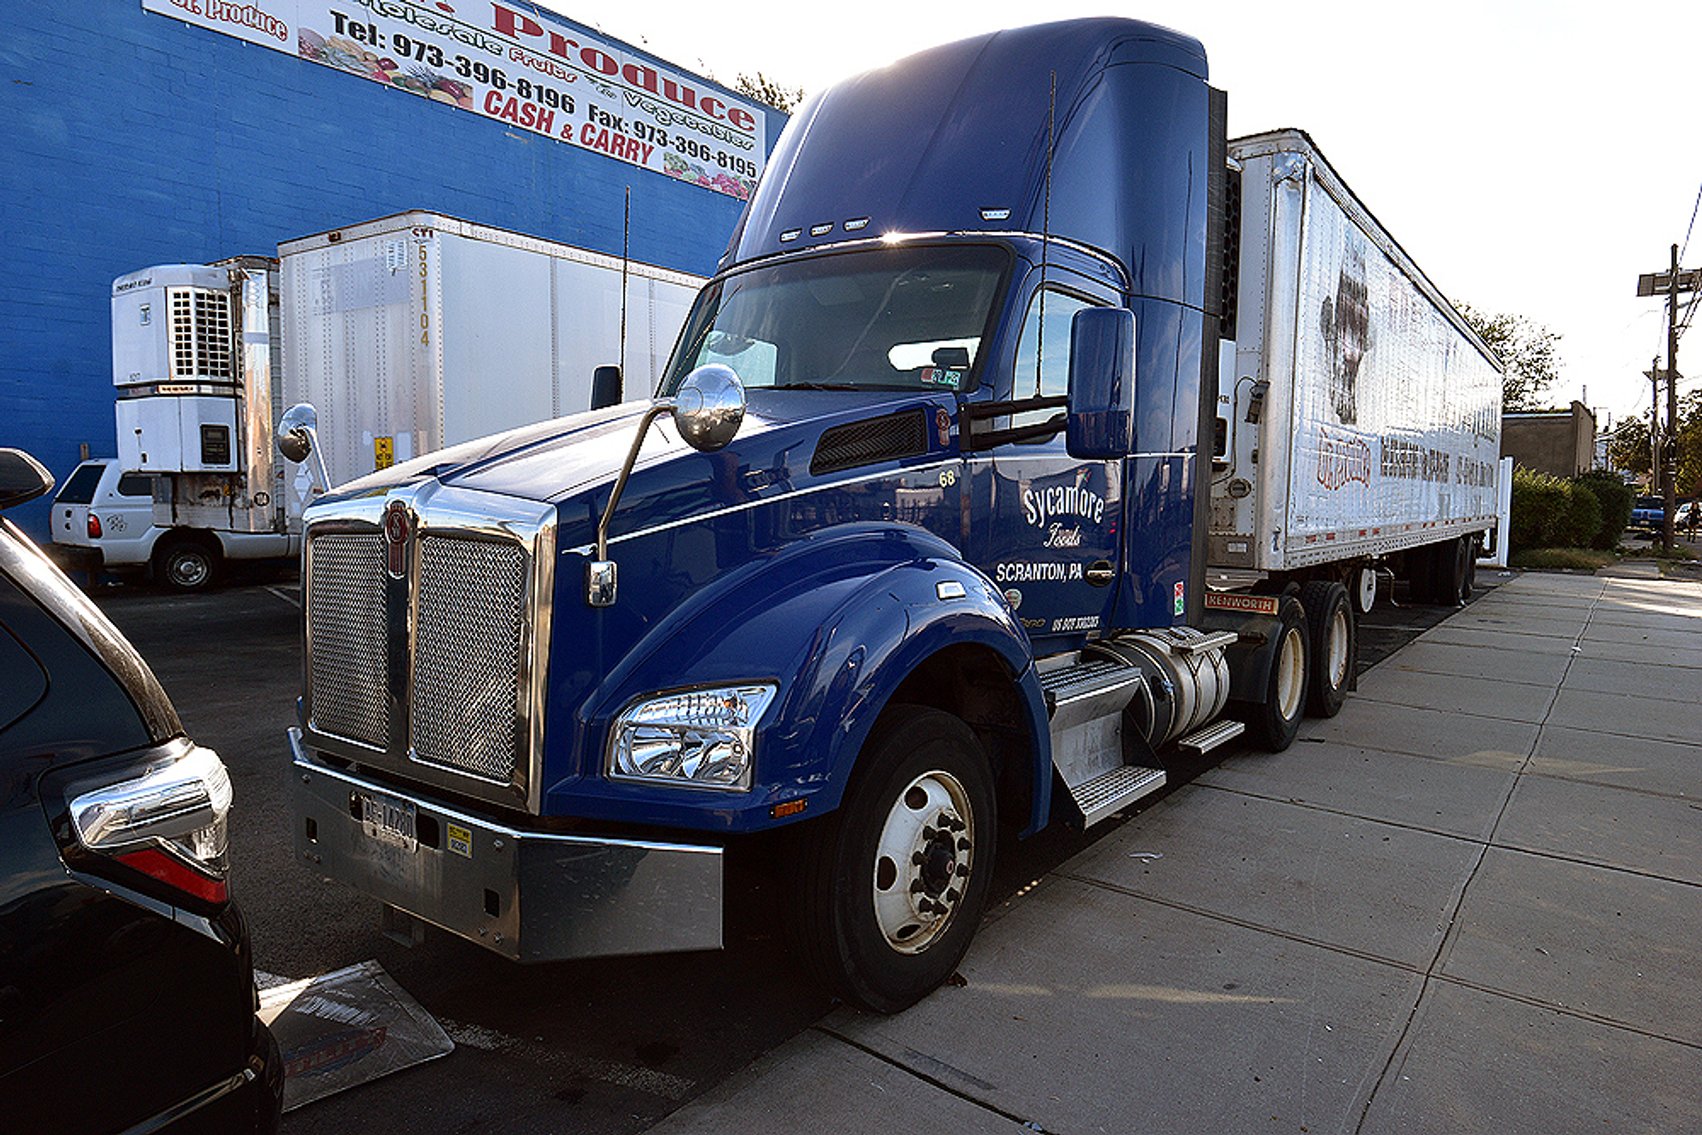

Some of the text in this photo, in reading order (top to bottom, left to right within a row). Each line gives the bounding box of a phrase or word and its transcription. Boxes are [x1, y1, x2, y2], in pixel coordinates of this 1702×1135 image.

[205, 0, 288, 41] Produce
[353, 0, 504, 56] olesale
[490, 2, 756, 132] Produce
[329, 9, 757, 178] Tel: 973-396-8196 Fax: 973-396-8195
[484, 90, 655, 165] CASH & CARRY
[418, 245, 430, 347] 531104
[939, 470, 955, 487] 68
[1024, 486, 1104, 529] Sycamore
[996, 563, 1083, 584] SCRANTON, PA
[1209, 595, 1273, 610] KENWORTH
